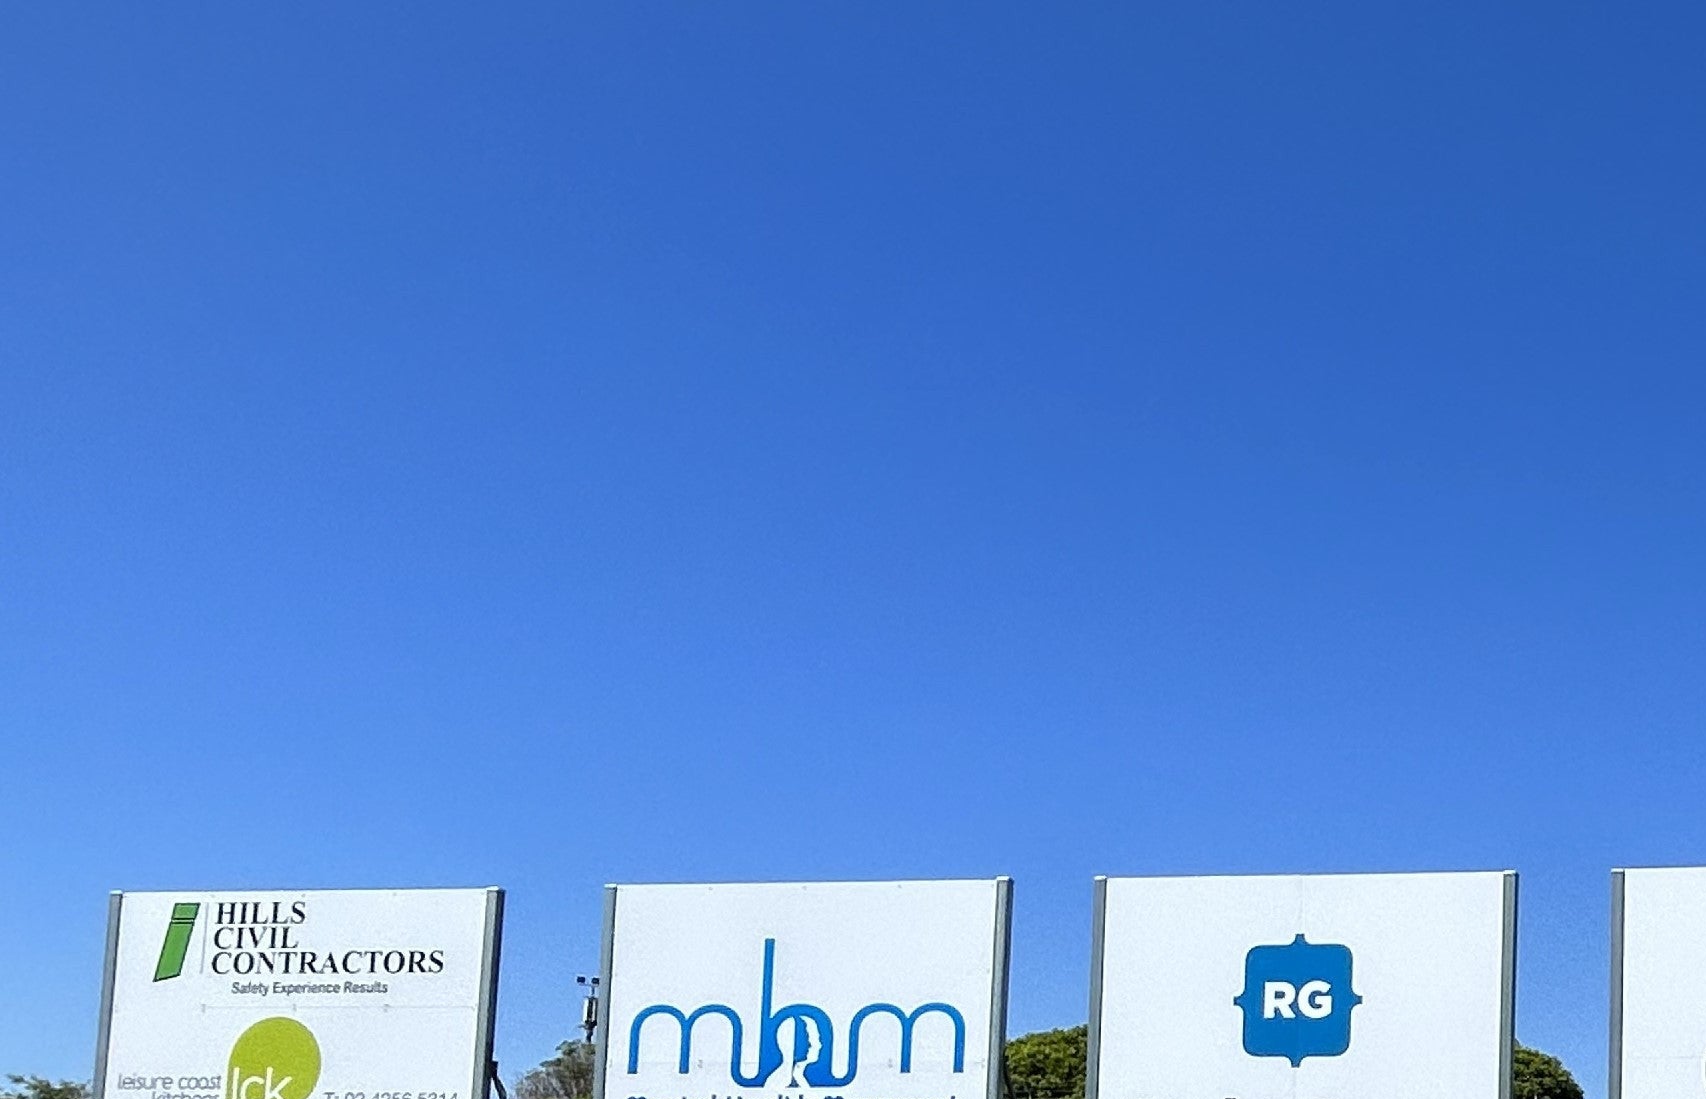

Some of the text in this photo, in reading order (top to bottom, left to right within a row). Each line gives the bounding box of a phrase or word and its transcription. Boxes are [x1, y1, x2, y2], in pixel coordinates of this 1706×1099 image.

[215, 901, 306, 925] HILLS
[213, 926, 299, 949] CIVIL
[211, 950, 444, 975] CONTRACTORS
[231, 981, 388, 996] Safety Experience Results
[1263, 979, 1333, 1019] RG
[118, 1074, 222, 1090] leisure coast
